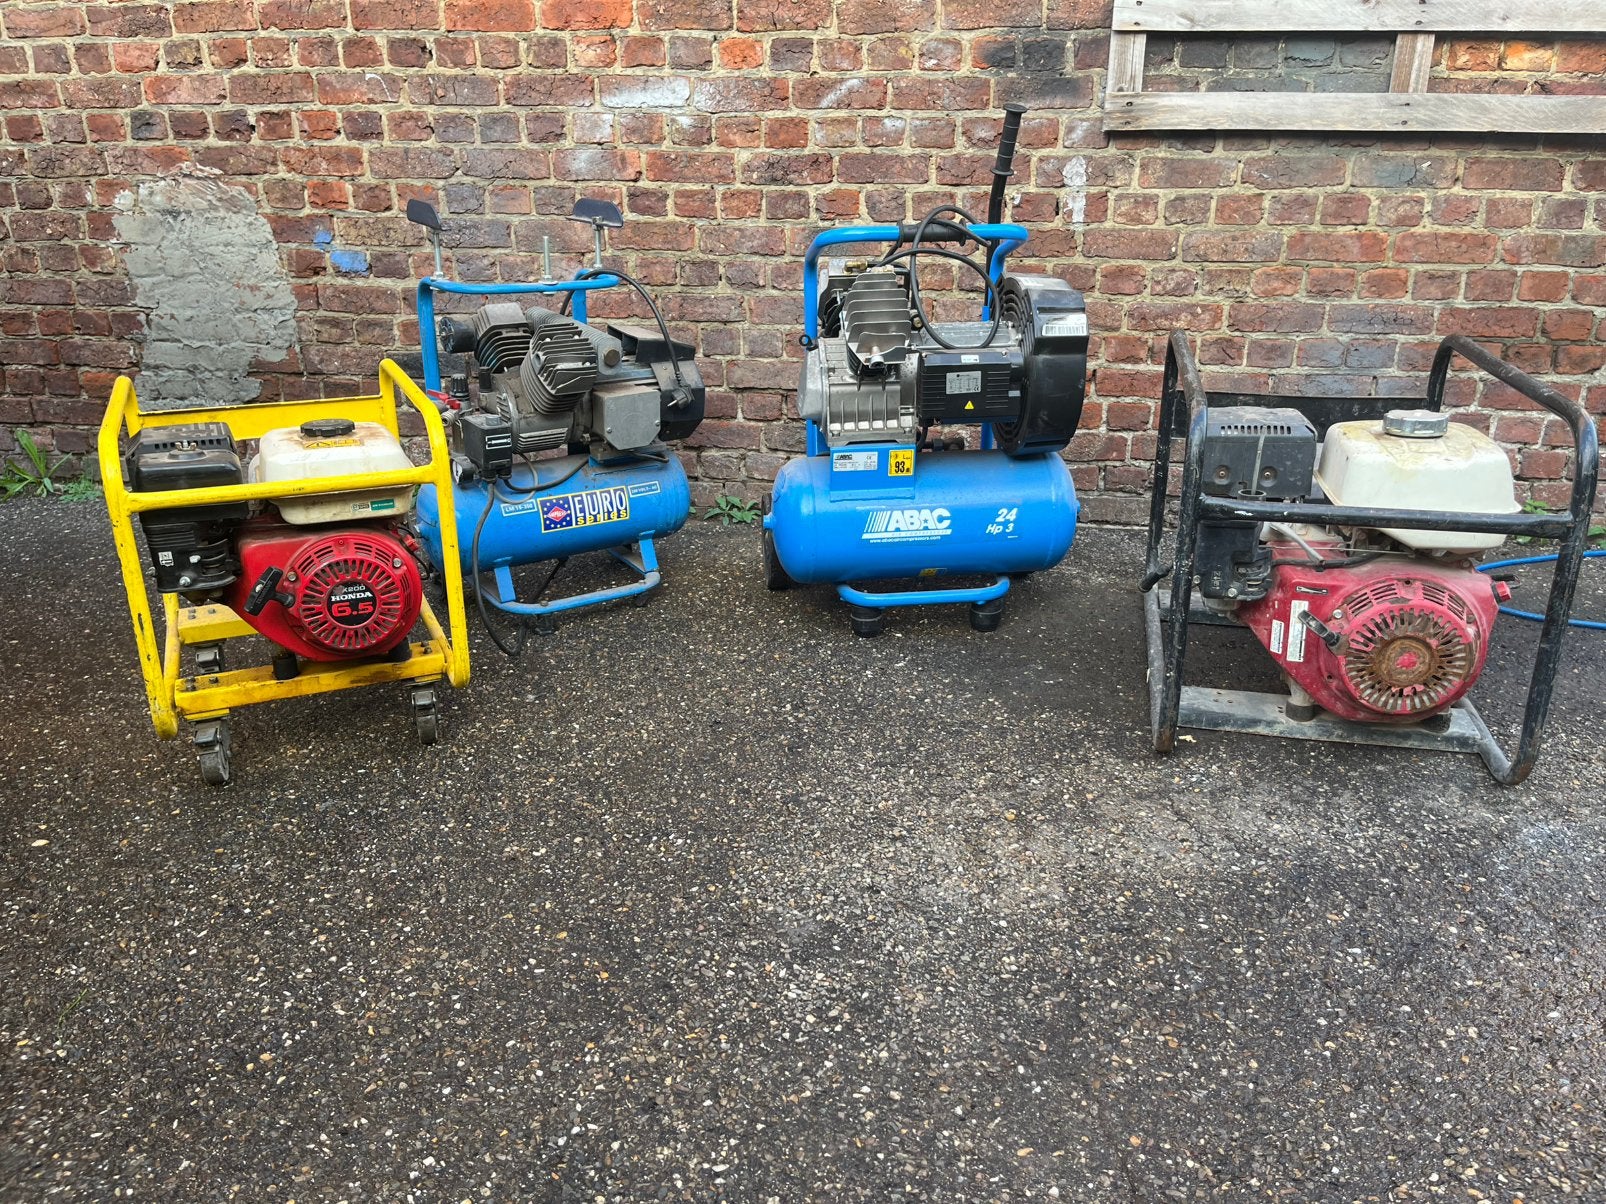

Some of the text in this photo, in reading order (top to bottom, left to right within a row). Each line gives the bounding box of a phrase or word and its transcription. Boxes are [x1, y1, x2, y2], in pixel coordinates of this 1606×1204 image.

[894, 461, 906, 473] 93
[574, 490, 627, 517] EURO
[577, 508, 627, 525] series
[886, 508, 951, 532] ABAC
[995, 507, 1018, 522] 24
[985, 522, 1015, 535] Hp 3
[331, 591, 373, 602] HONDA
[332, 602, 374, 617] 6.5
